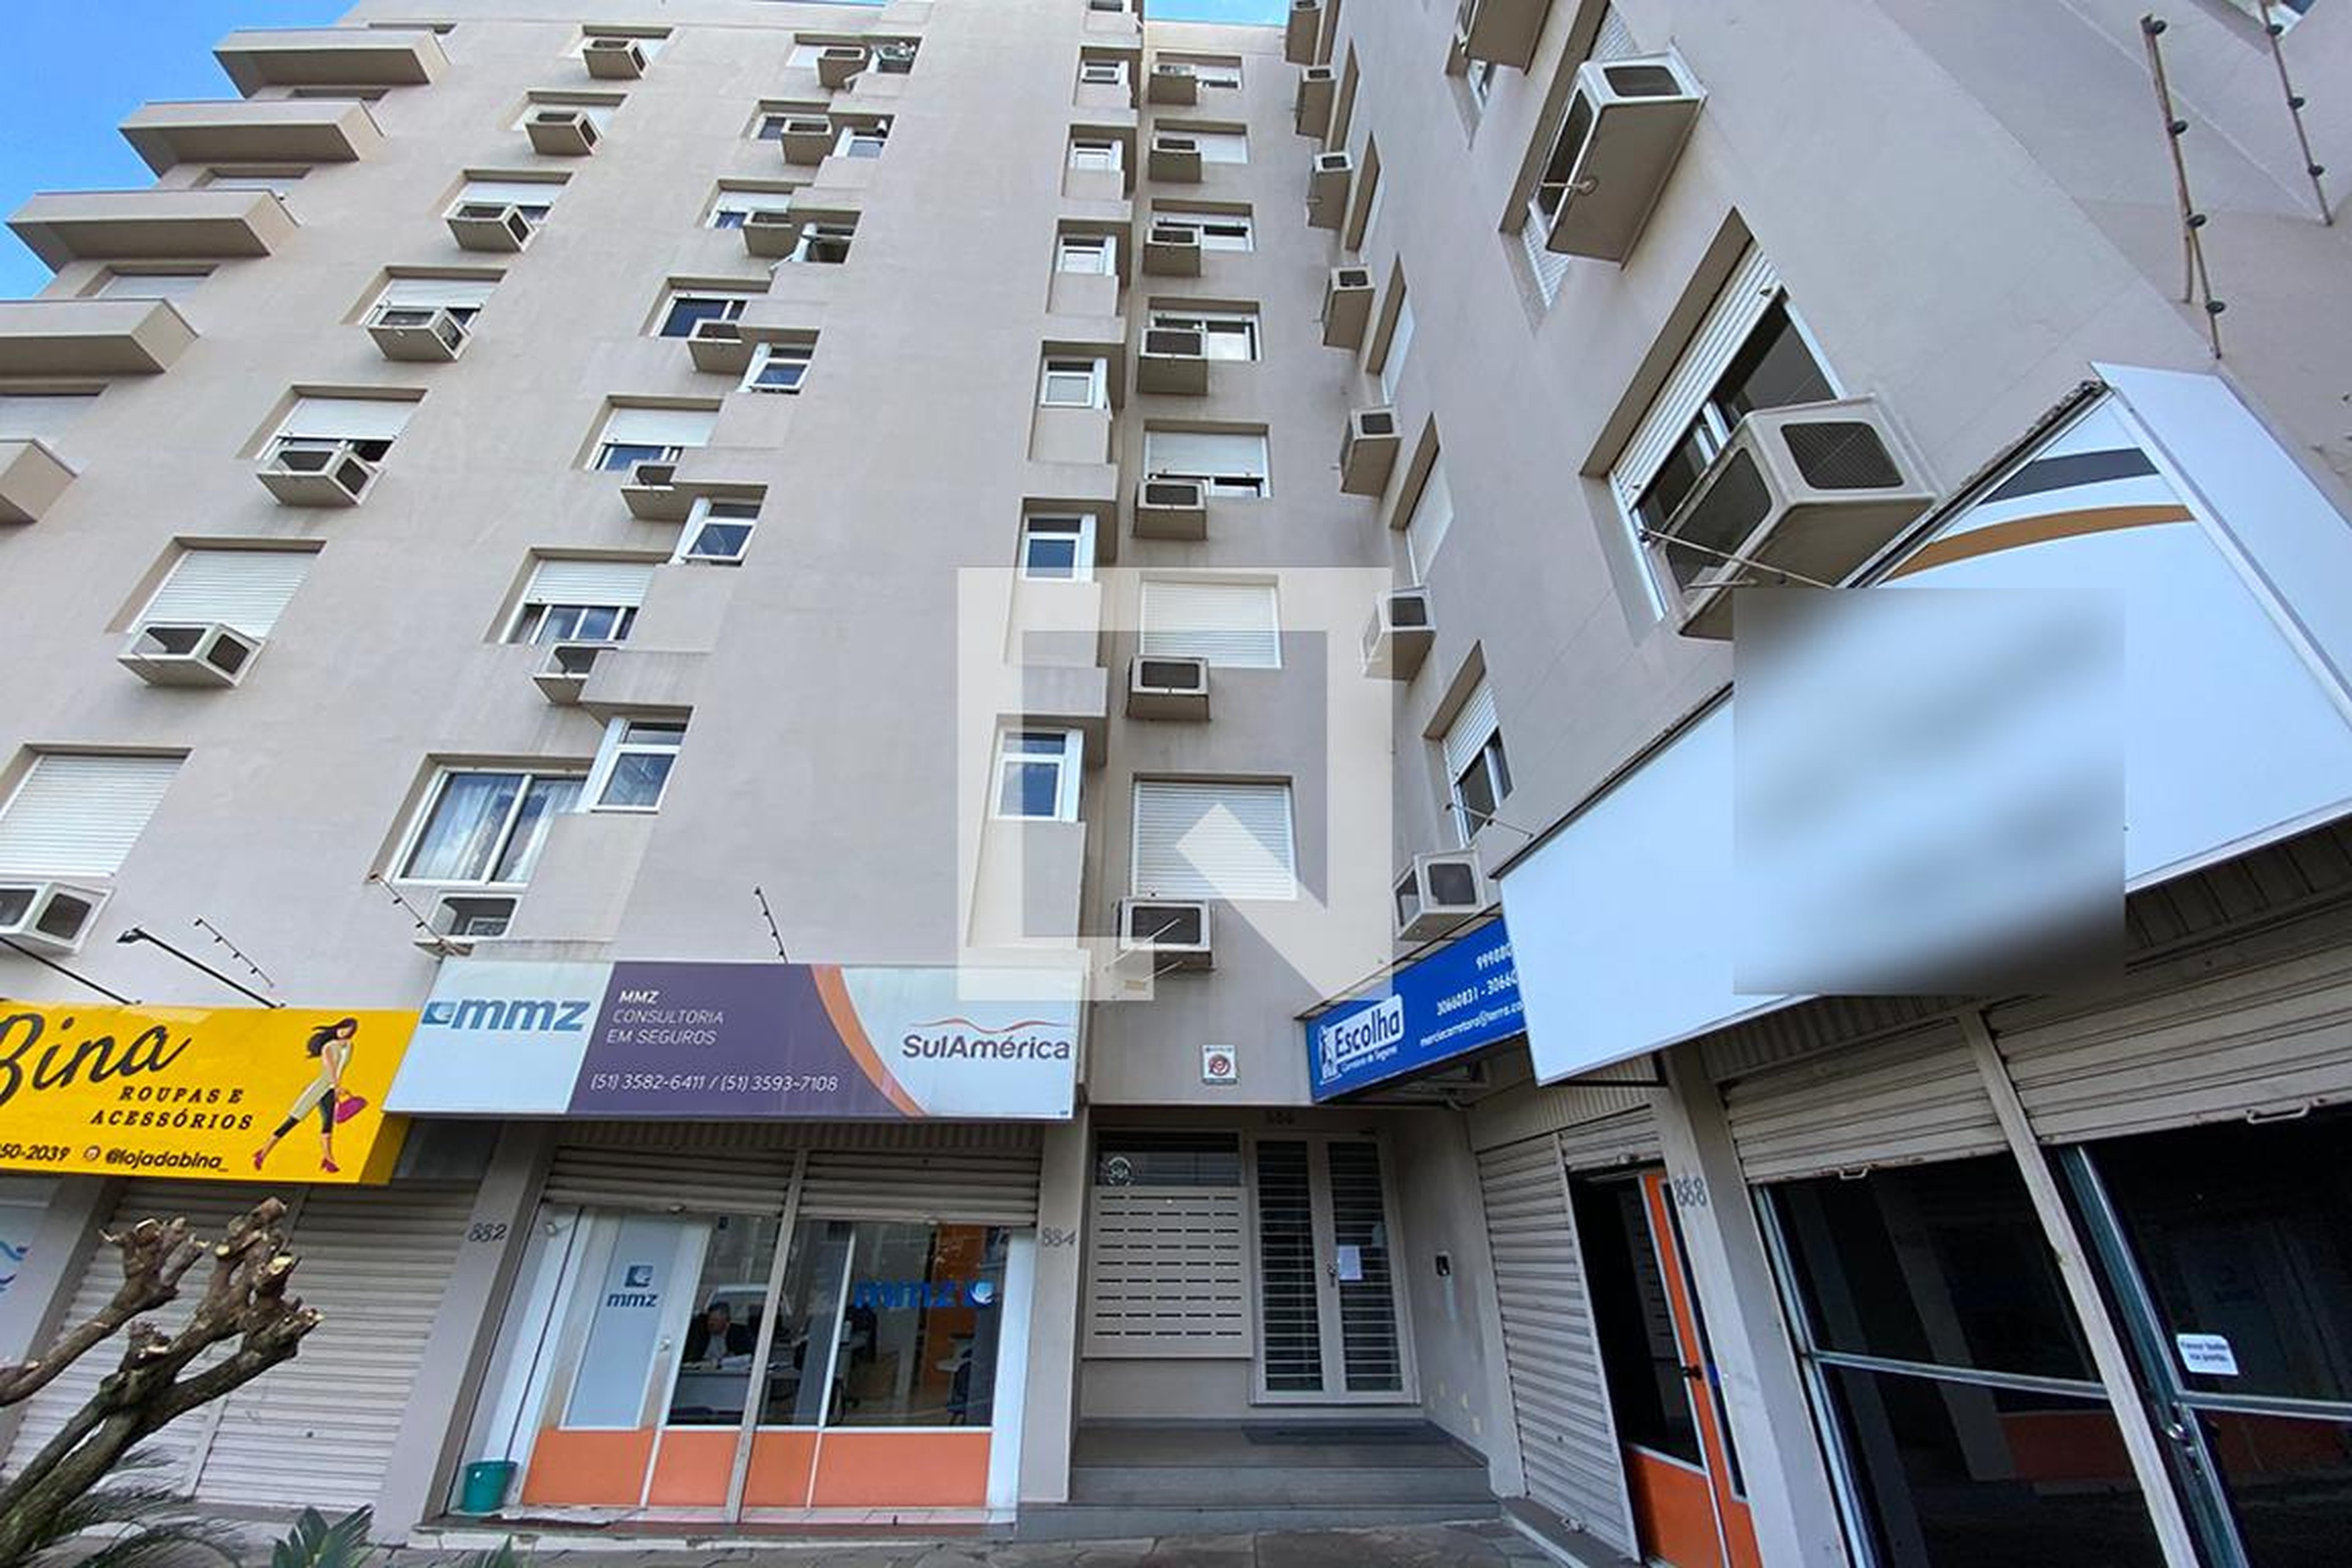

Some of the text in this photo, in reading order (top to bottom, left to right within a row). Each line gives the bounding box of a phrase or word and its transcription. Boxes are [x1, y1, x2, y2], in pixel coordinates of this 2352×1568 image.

[618, 990, 659, 1004] MMZ
[451, 998, 592, 1031] mmz
[612, 1009, 724, 1025] CONSULTORIA
[606, 1029, 717, 1045] EM SEGUROS
[1335, 1008, 1400, 1058] Escolha
[902, 1033, 1071, 1059] SulAmérica
[590, 1073, 619, 1091] (51)
[622, 1074, 704, 1091] 3582-6411
[720, 1075, 749, 1092] (51)
[752, 1076, 838, 1092] 3593-7108
[119, 1086, 244, 1104] ROUPAS E
[90, 1108, 253, 1130] ACESSÓRIOS
[468, 1223, 507, 1243] 882
[1042, 1226, 1077, 1247] 884
[606, 1293, 658, 1308] mmz
